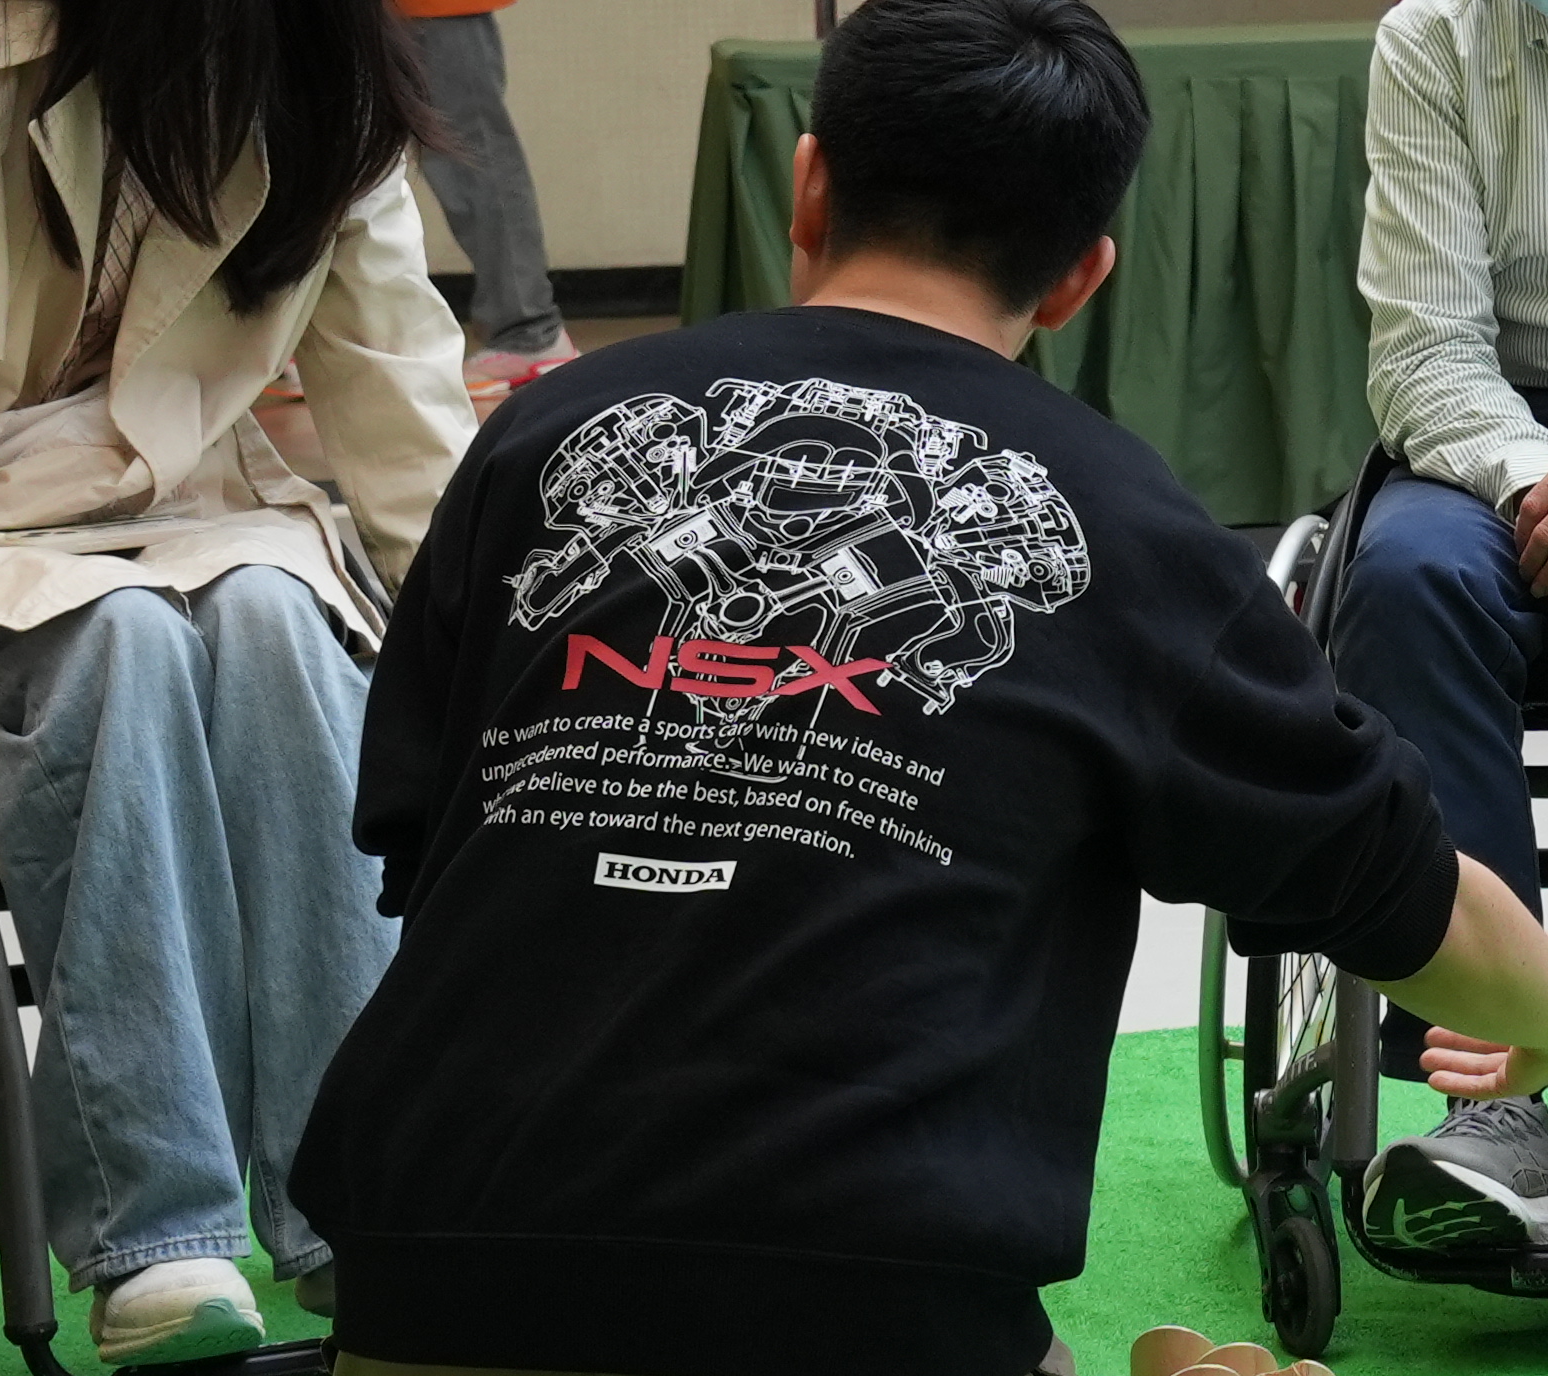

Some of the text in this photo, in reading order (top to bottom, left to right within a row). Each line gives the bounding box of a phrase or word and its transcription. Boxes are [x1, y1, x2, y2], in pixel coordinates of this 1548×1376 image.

[561, 632, 898, 718] NSX
[481, 740, 919, 812] unprecedented performance. We want to create
[482, 727, 510, 749] We
[514, 718, 551, 743] want
[552, 716, 571, 733] to
[574, 713, 635, 731] create
[638, 718, 651, 733] a
[654, 719, 716, 741] sports
[755, 722, 799, 744] with
[802, 728, 849, 751] new
[851, 736, 904, 770] ideas
[906, 759, 947, 787] and
[520, 808, 545, 825] an
[550, 809, 584, 830] eye
[588, 811, 659, 832] toward
[662, 813, 696, 836] the
[700, 820, 741, 838] next
[743, 822, 855, 860] generation.
[527, 771, 597, 794] believe
[601, 778, 623, 796] to
[626, 777, 653, 799] be
[656, 779, 689, 800] the
[693, 781, 740, 807] best,
[743, 786, 802, 809] based
[805, 796, 832, 816] on
[836, 799, 876, 830] free
[879, 816, 954, 867] thinking
[603, 860, 728, 886] HONDA
